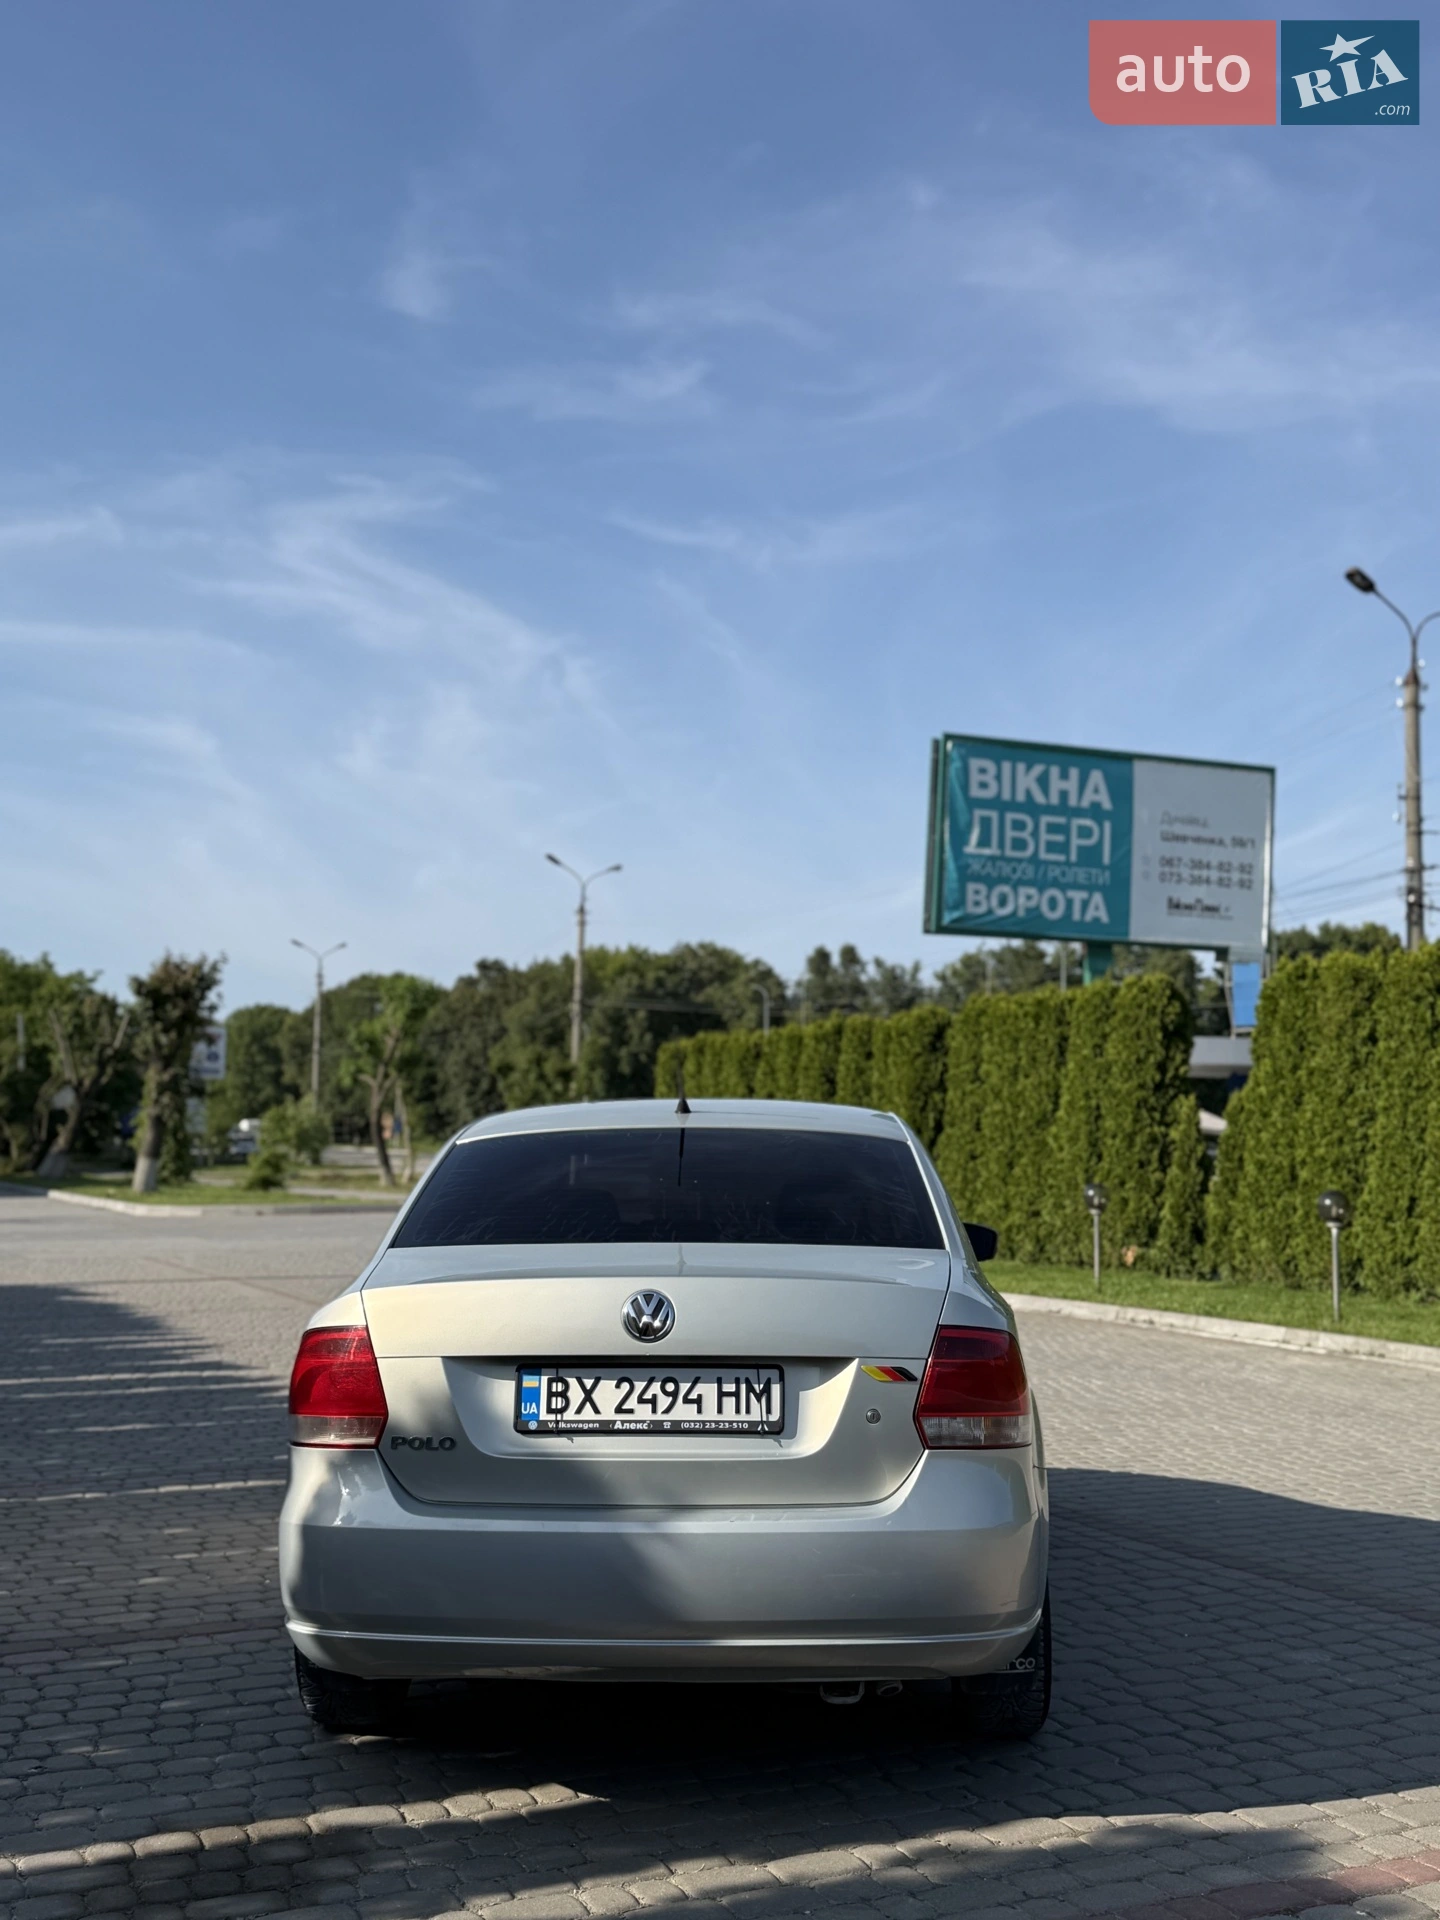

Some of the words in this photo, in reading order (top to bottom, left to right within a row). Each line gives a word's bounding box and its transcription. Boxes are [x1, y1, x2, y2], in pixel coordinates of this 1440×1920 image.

[968, 757, 1113, 811] ВІКНА
[963, 809, 1112, 866] ДВЕРІ
[965, 881, 1110, 924] ВОРОТА
[521, 1402, 538, 1415] UA
[546, 1376, 602, 1415] BX
[613, 1376, 702, 1415] 2494
[716, 1376, 772, 1415] HM
[391, 1435, 456, 1451] POLO
[680, 1421, 703, 1430] (032)
[704, 1421, 749, 1430] 23-23-510
